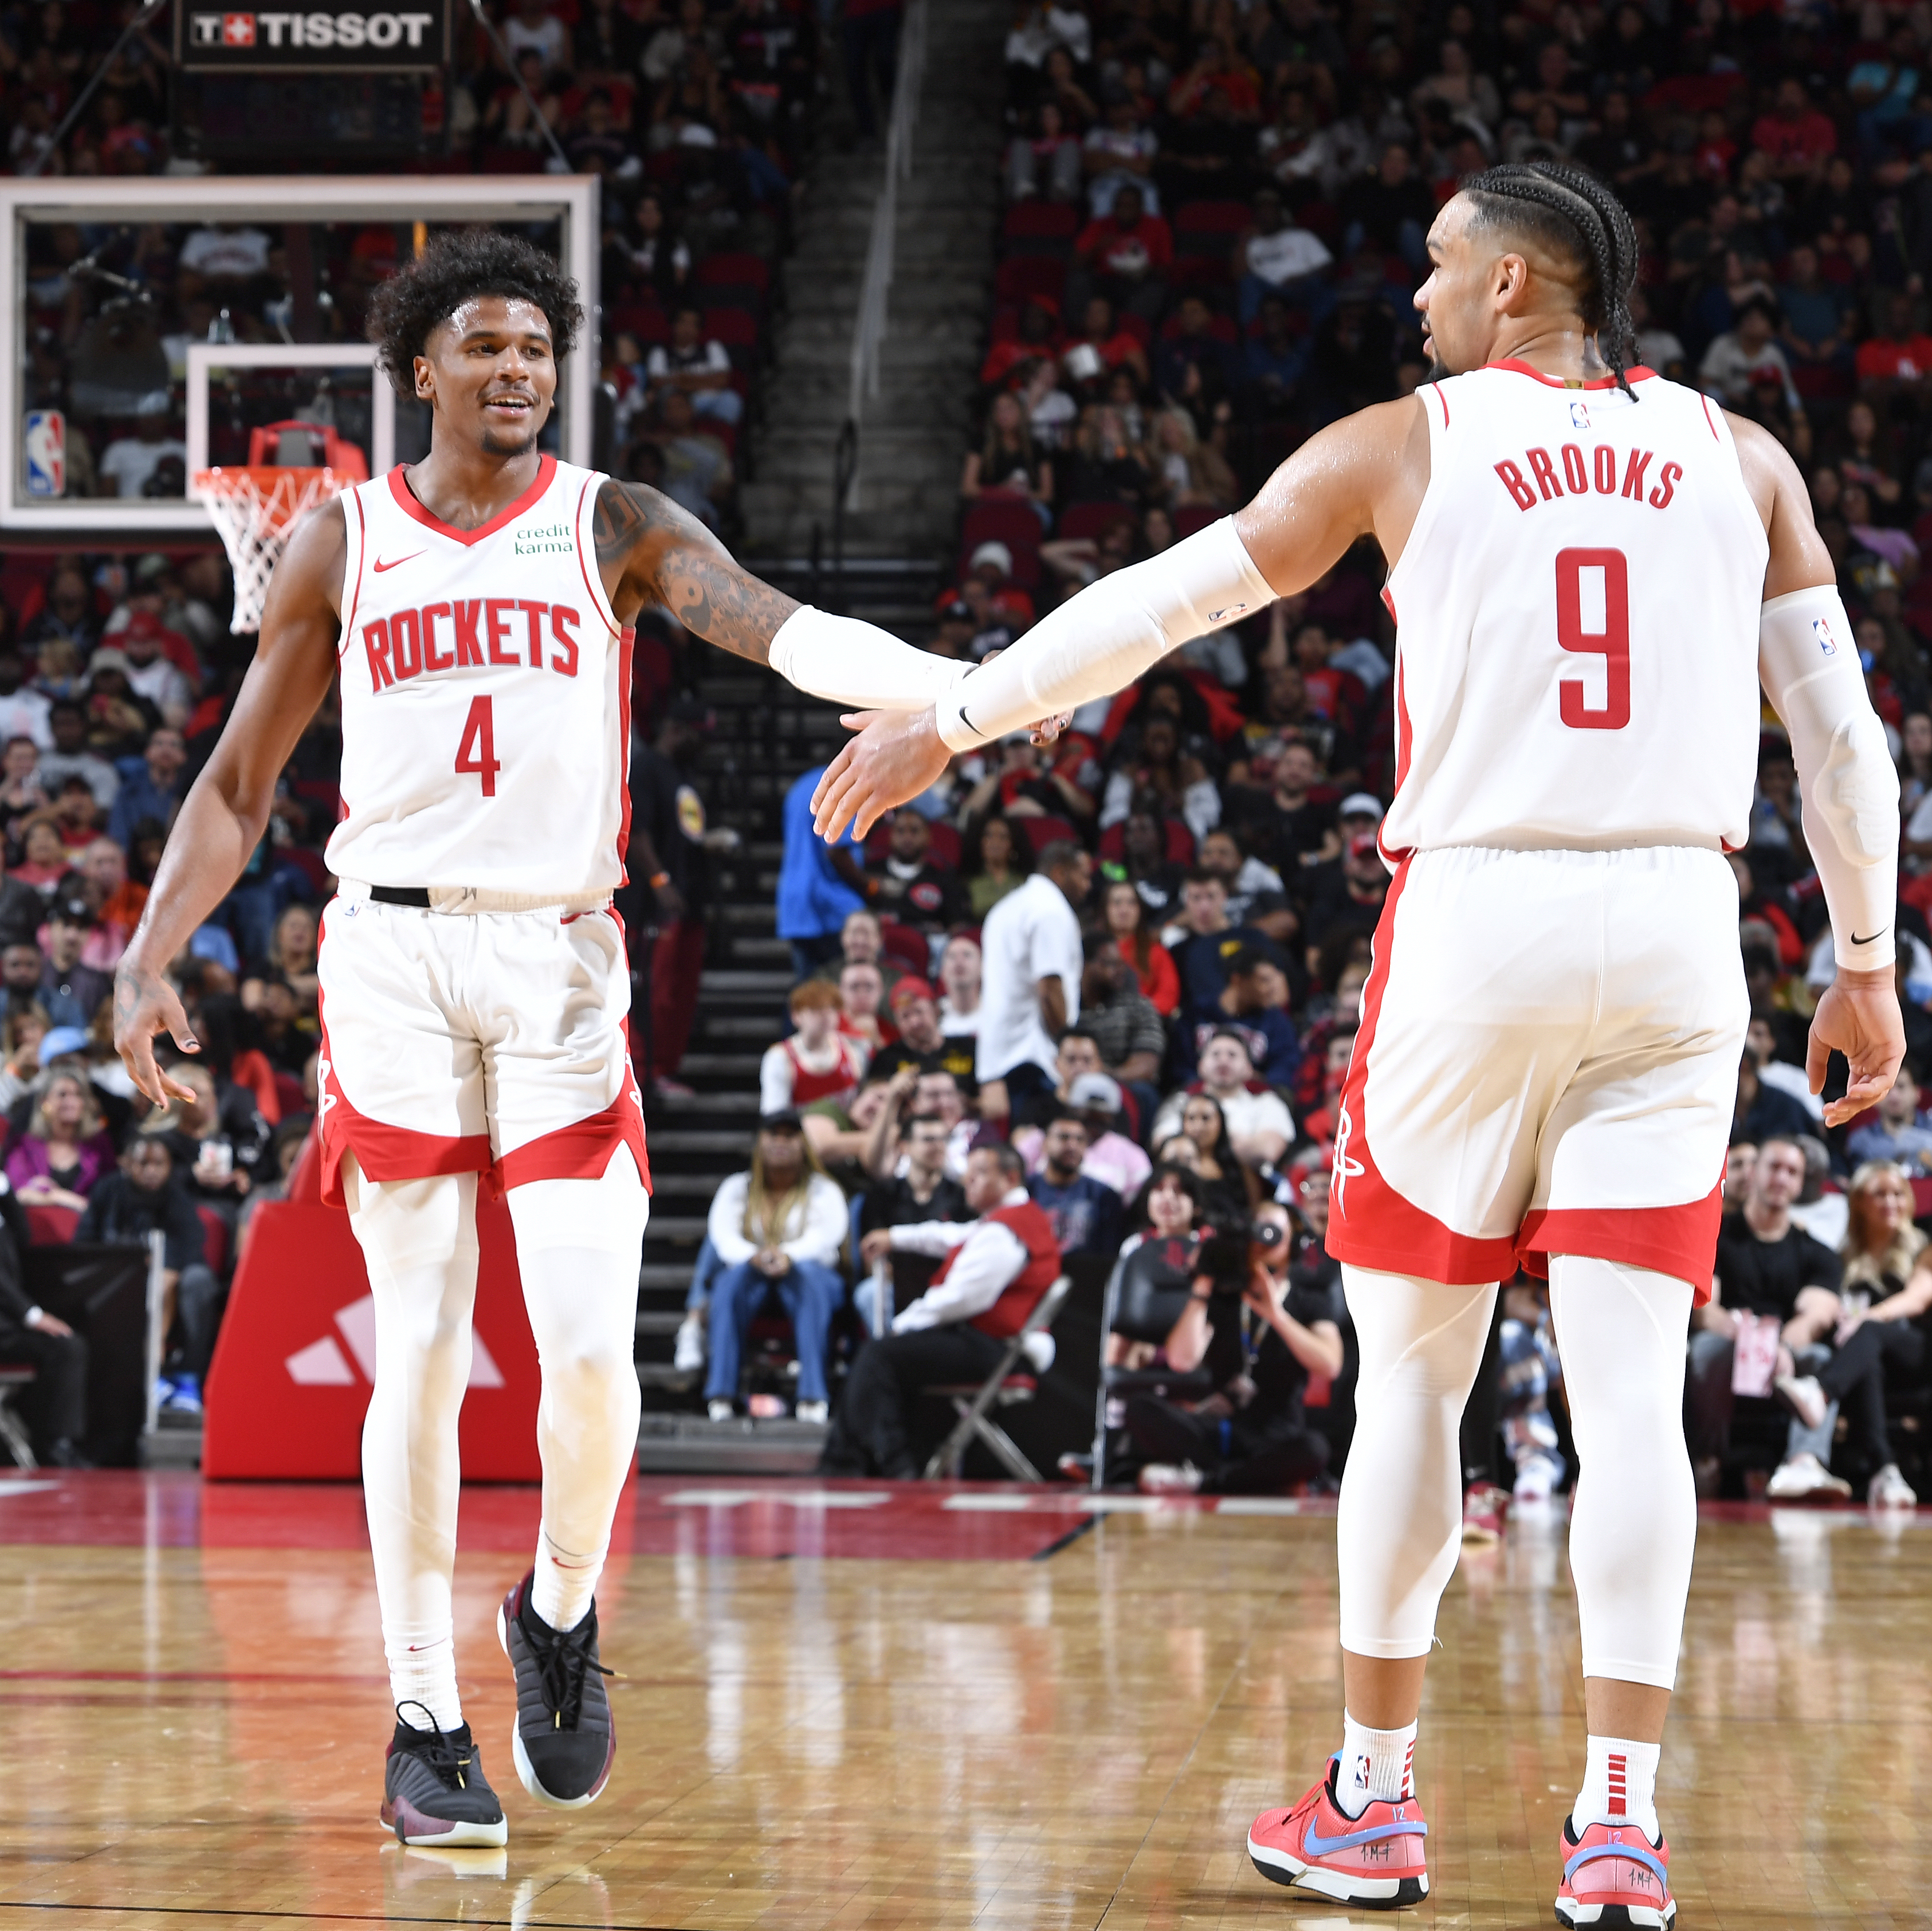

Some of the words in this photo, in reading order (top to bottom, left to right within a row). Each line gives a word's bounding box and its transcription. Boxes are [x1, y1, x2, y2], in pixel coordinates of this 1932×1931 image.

[259, 13, 433, 47] TISSOT
[1493, 442, 1683, 512] BROOKS
[515, 541, 573, 555] karma
[517, 524, 571, 539] credit
[362, 598, 581, 696] ROCKETS
[1556, 546, 1631, 729] 9
[455, 694, 501, 797] 4
